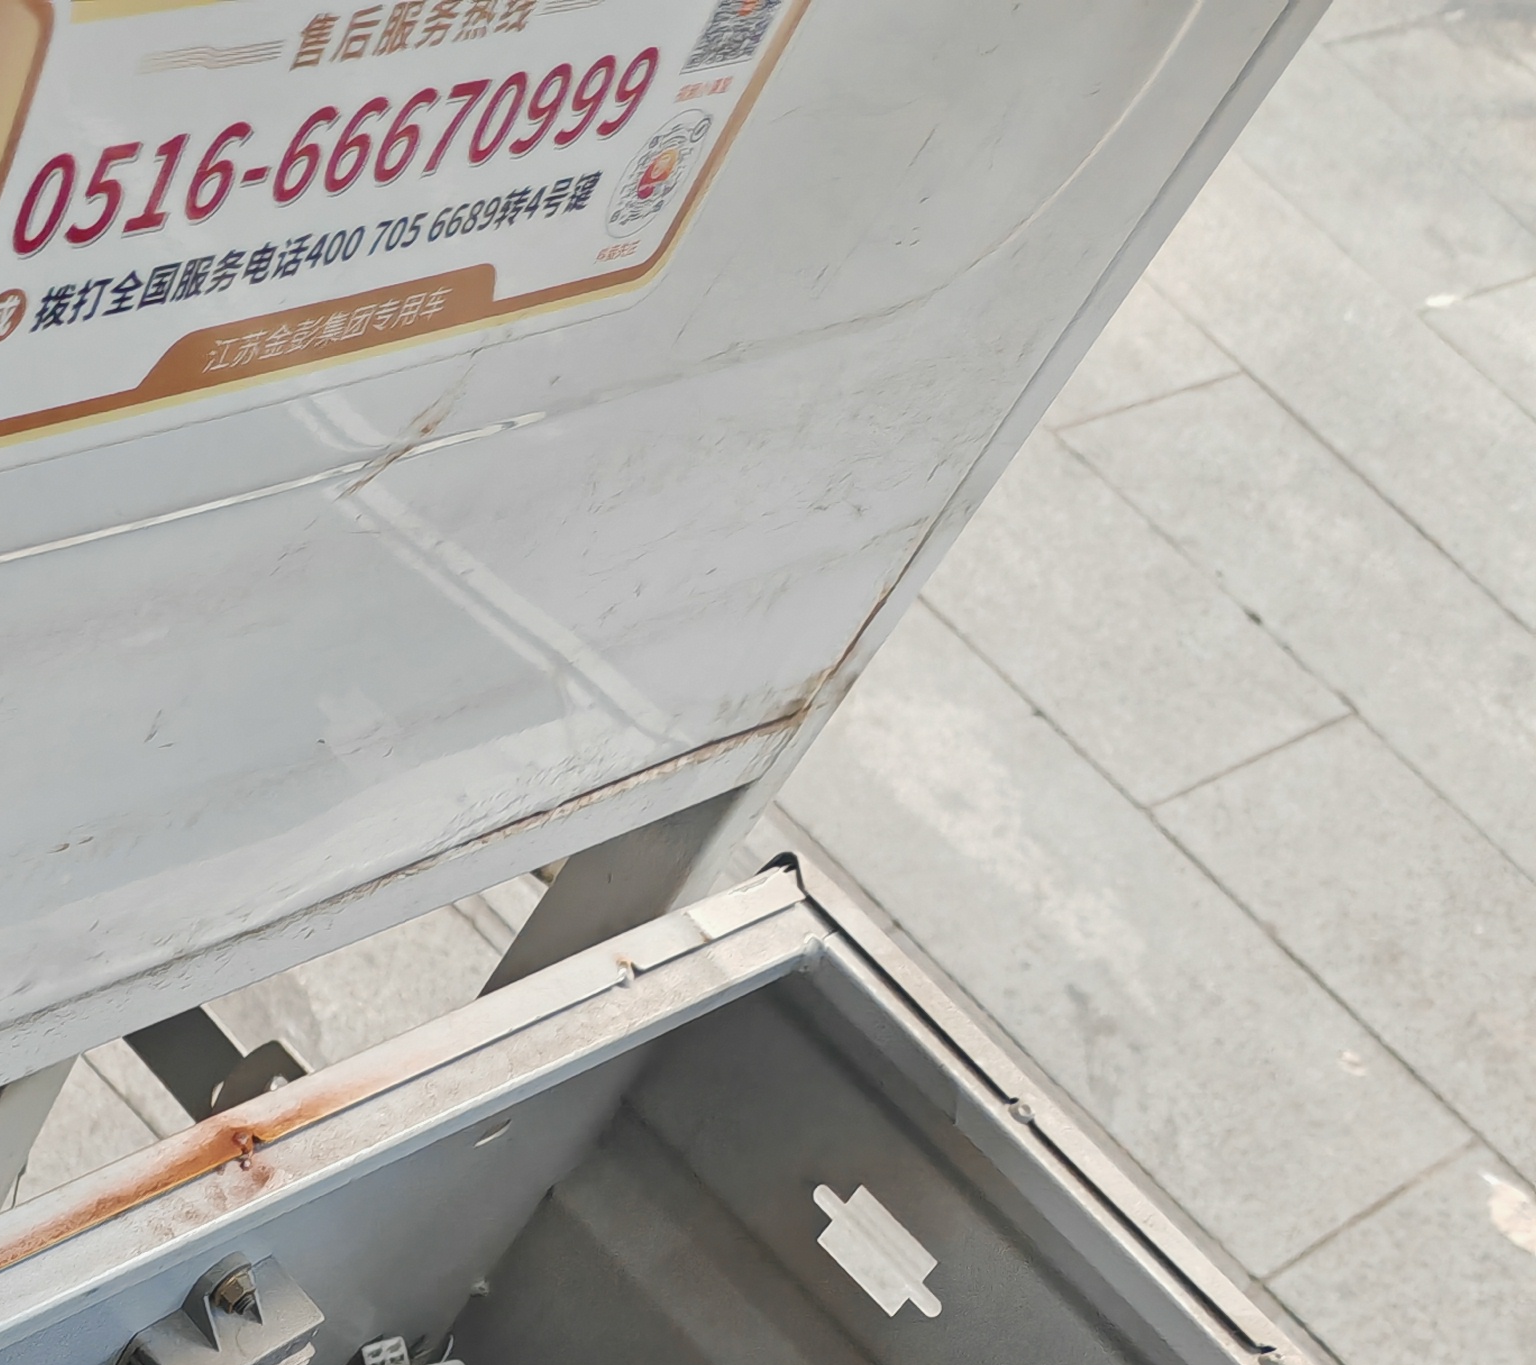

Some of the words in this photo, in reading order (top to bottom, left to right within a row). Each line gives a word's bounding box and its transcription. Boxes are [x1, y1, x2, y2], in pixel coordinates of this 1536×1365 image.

[12, 46, 661, 258] 0516-66670999
[30, 225, 367, 333] 拨打全国服务电话400
[372, 205, 427, 254] 705
[428, 169, 604, 237] 6689转4号键
[200, 287, 453, 375] 江苏金彭集团专用车
